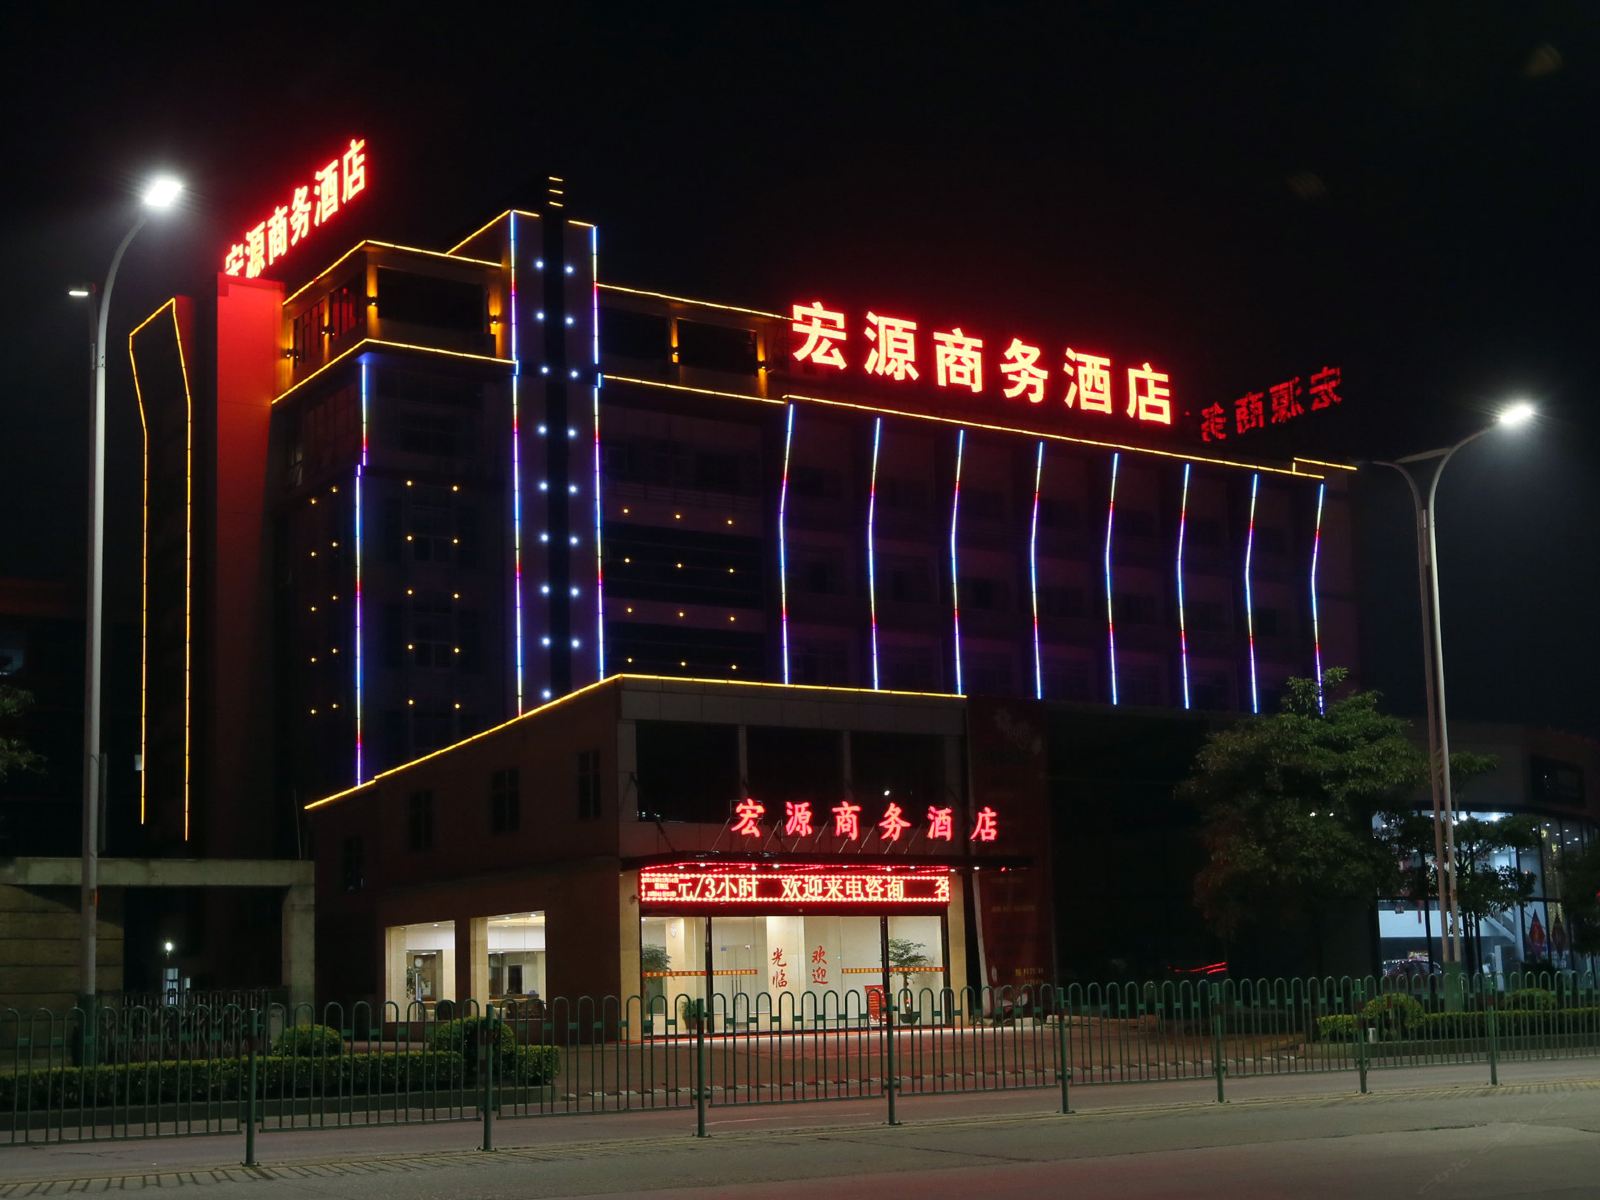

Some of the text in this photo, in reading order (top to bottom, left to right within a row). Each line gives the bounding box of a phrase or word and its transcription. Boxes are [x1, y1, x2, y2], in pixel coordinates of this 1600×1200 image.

[224, 138, 366, 279] 宏源商务酒店
[791, 301, 1172, 425] 宏源商务酒店
[730, 798, 998, 842] 宏源商务酒店
[780, 876, 905, 899] 欢迎来电咨询
[771, 947, 788, 988] 光临
[811, 945, 829, 985] 欢迎
